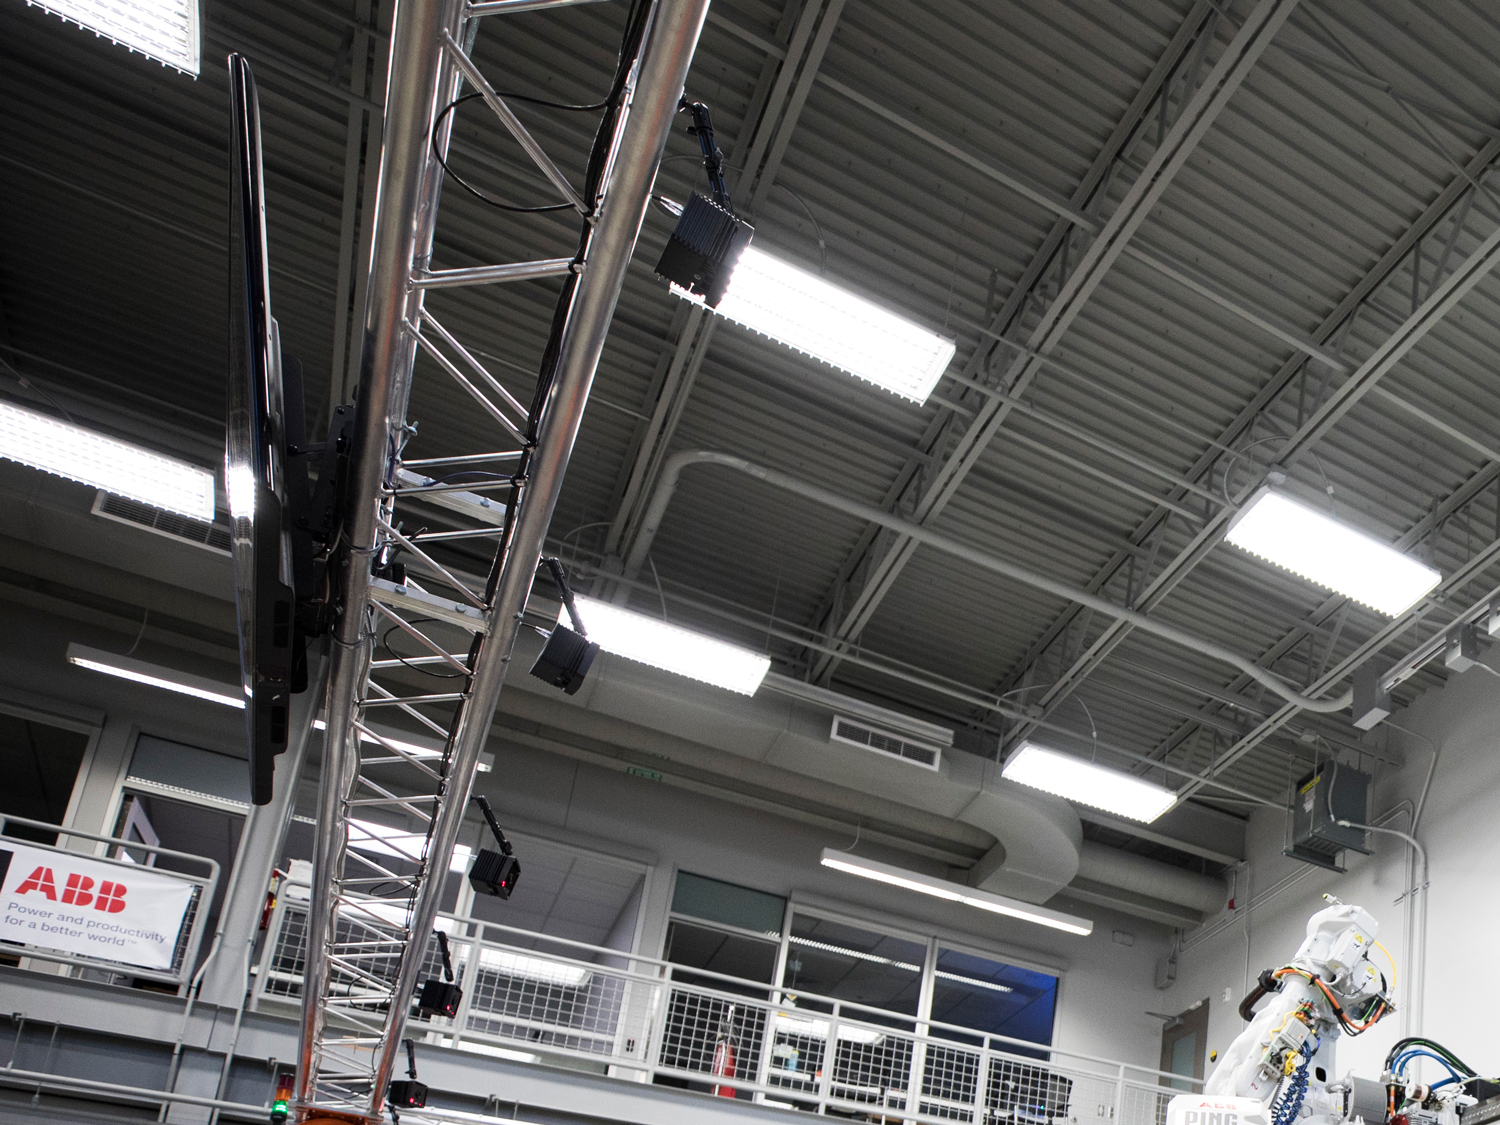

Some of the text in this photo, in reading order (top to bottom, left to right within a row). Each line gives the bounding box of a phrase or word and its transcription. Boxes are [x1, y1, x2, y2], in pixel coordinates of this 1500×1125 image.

[14, 866, 127, 913] ABB
[4, 914, 26, 926] for
[28, 920, 37, 929] a
[41, 922, 84, 939] better
[7, 902, 167, 944] Power and productivity
